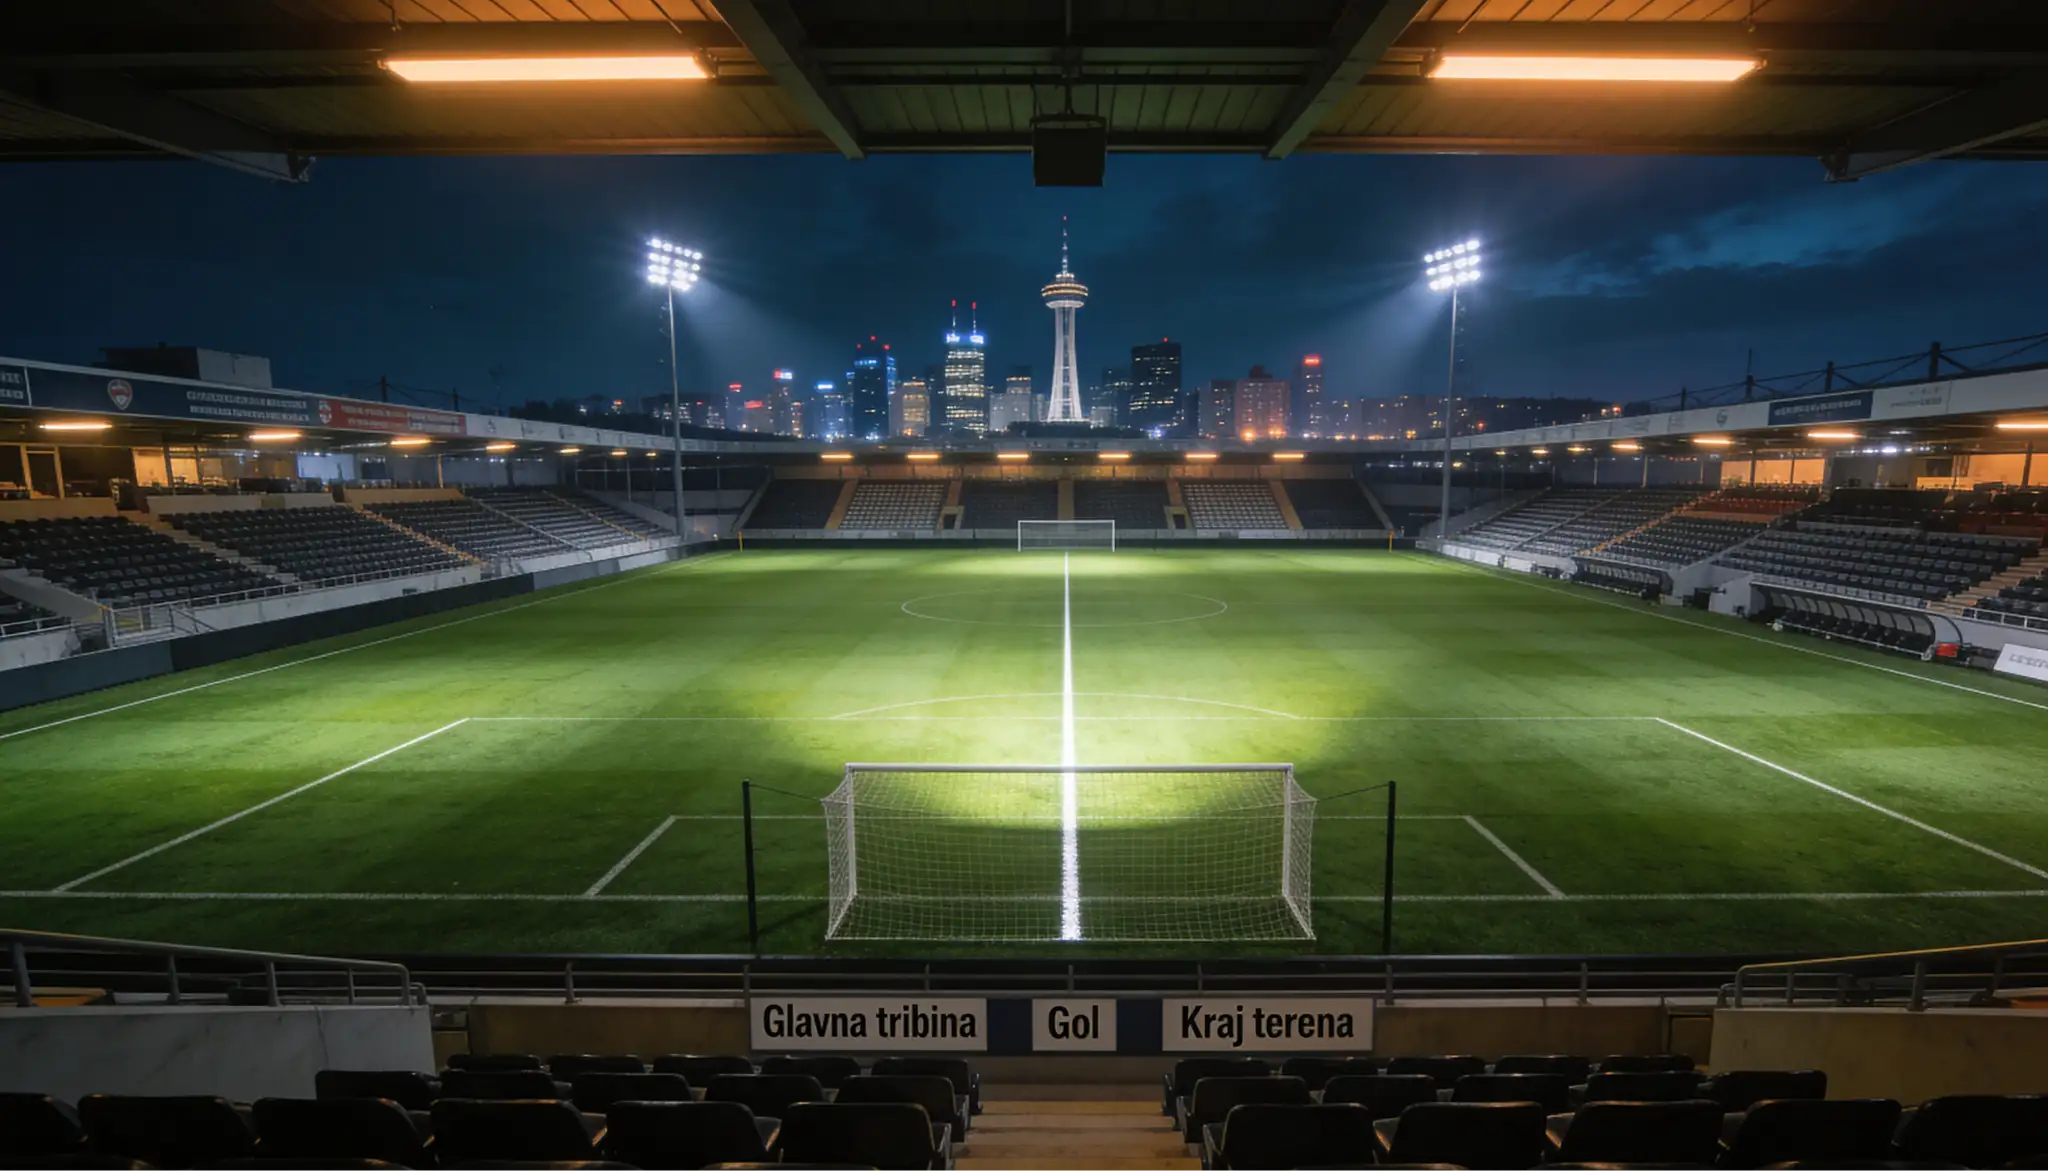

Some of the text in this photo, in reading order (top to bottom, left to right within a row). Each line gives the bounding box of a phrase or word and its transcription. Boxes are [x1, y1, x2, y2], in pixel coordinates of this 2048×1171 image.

[763, 1003, 977, 1038] Glavna tribina
[1048, 1004, 1099, 1039] Gol
[1181, 1004, 1354, 1048] Kraj terena
